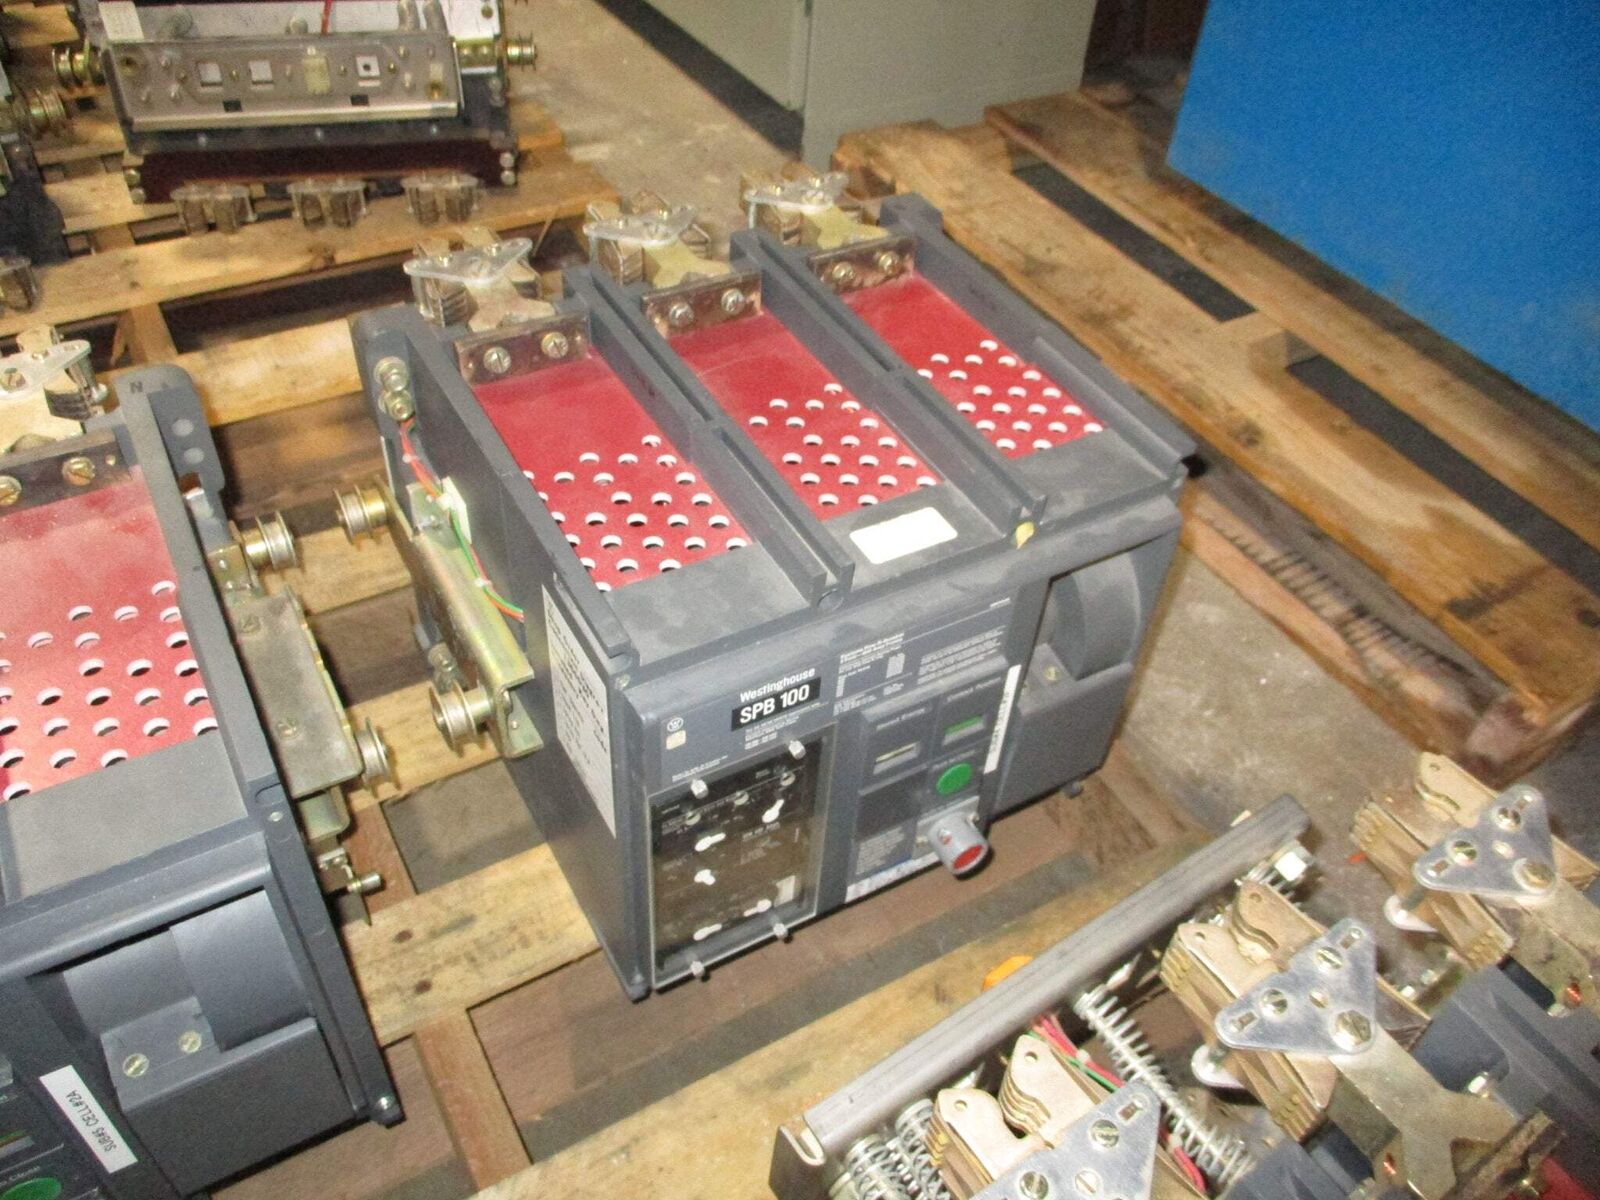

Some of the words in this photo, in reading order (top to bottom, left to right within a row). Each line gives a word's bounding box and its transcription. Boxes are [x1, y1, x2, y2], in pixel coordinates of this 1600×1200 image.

[740, 668, 816, 703] Westinghouse
[740, 697, 775, 724] SPB
[780, 684, 810, 709] 100
